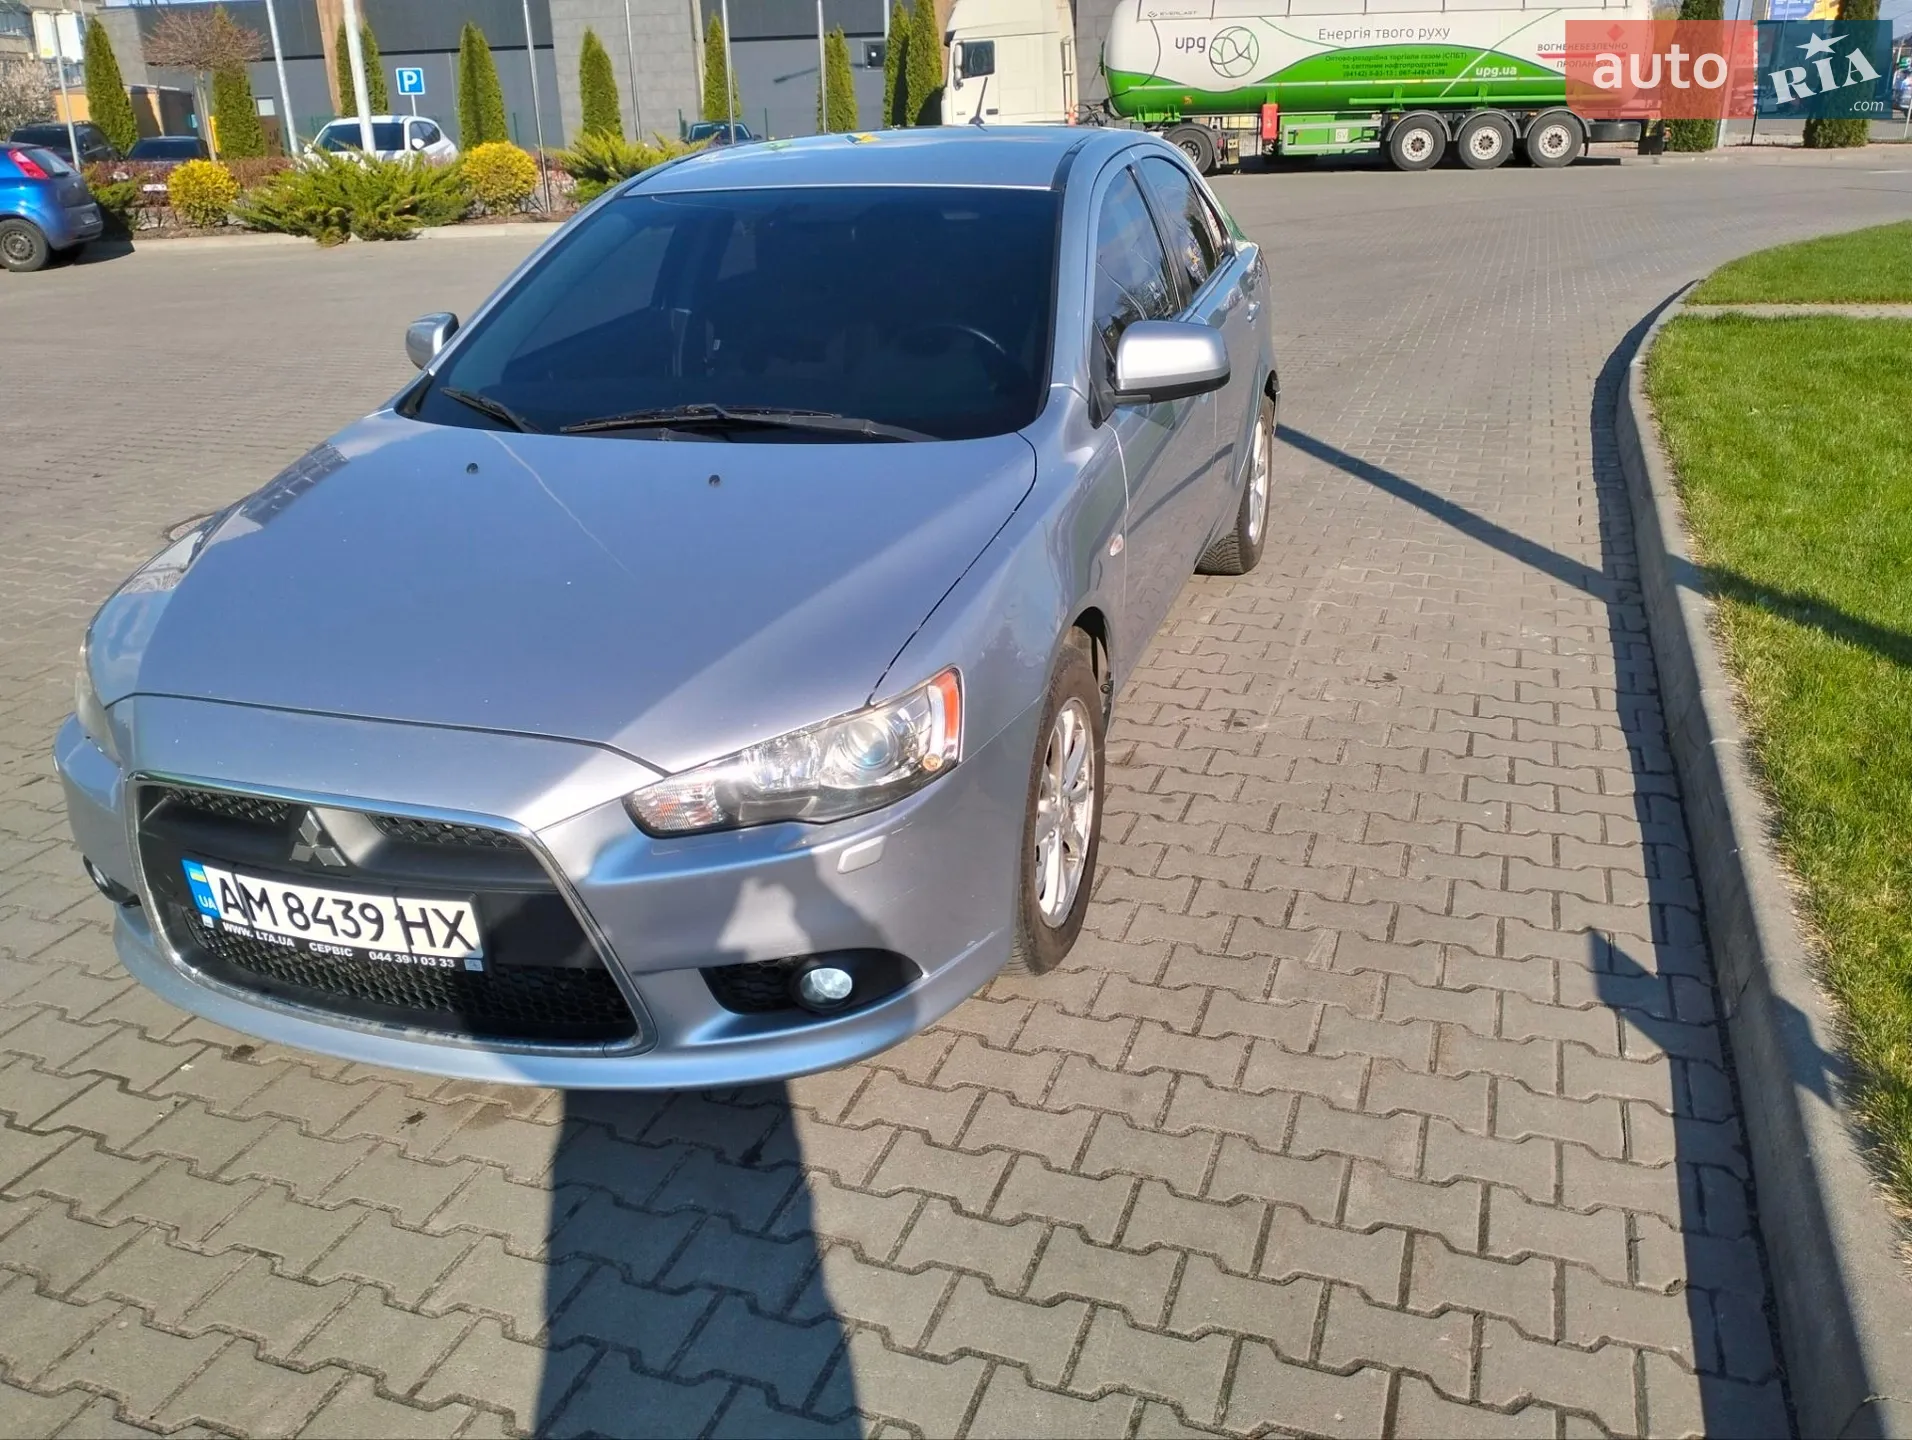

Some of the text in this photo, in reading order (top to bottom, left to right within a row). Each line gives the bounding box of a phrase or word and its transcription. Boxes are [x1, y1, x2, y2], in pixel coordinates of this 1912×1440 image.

[1318, 27, 1451, 41] Енергія твого руху
[1175, 36, 1206, 53] upg
[1475, 66, 1517, 77] upg.ua
[402, 70, 418, 92] P
[199, 895, 217, 910] UA
[219, 877, 476, 951] AM 8439 HX
[256, 931, 295, 948] LTA.UA
[308, 942, 353, 957] СЕРВІС
[368, 951, 392, 962] 044
[421, 956, 436, 966] 03
[439, 958, 455, 968] 33
